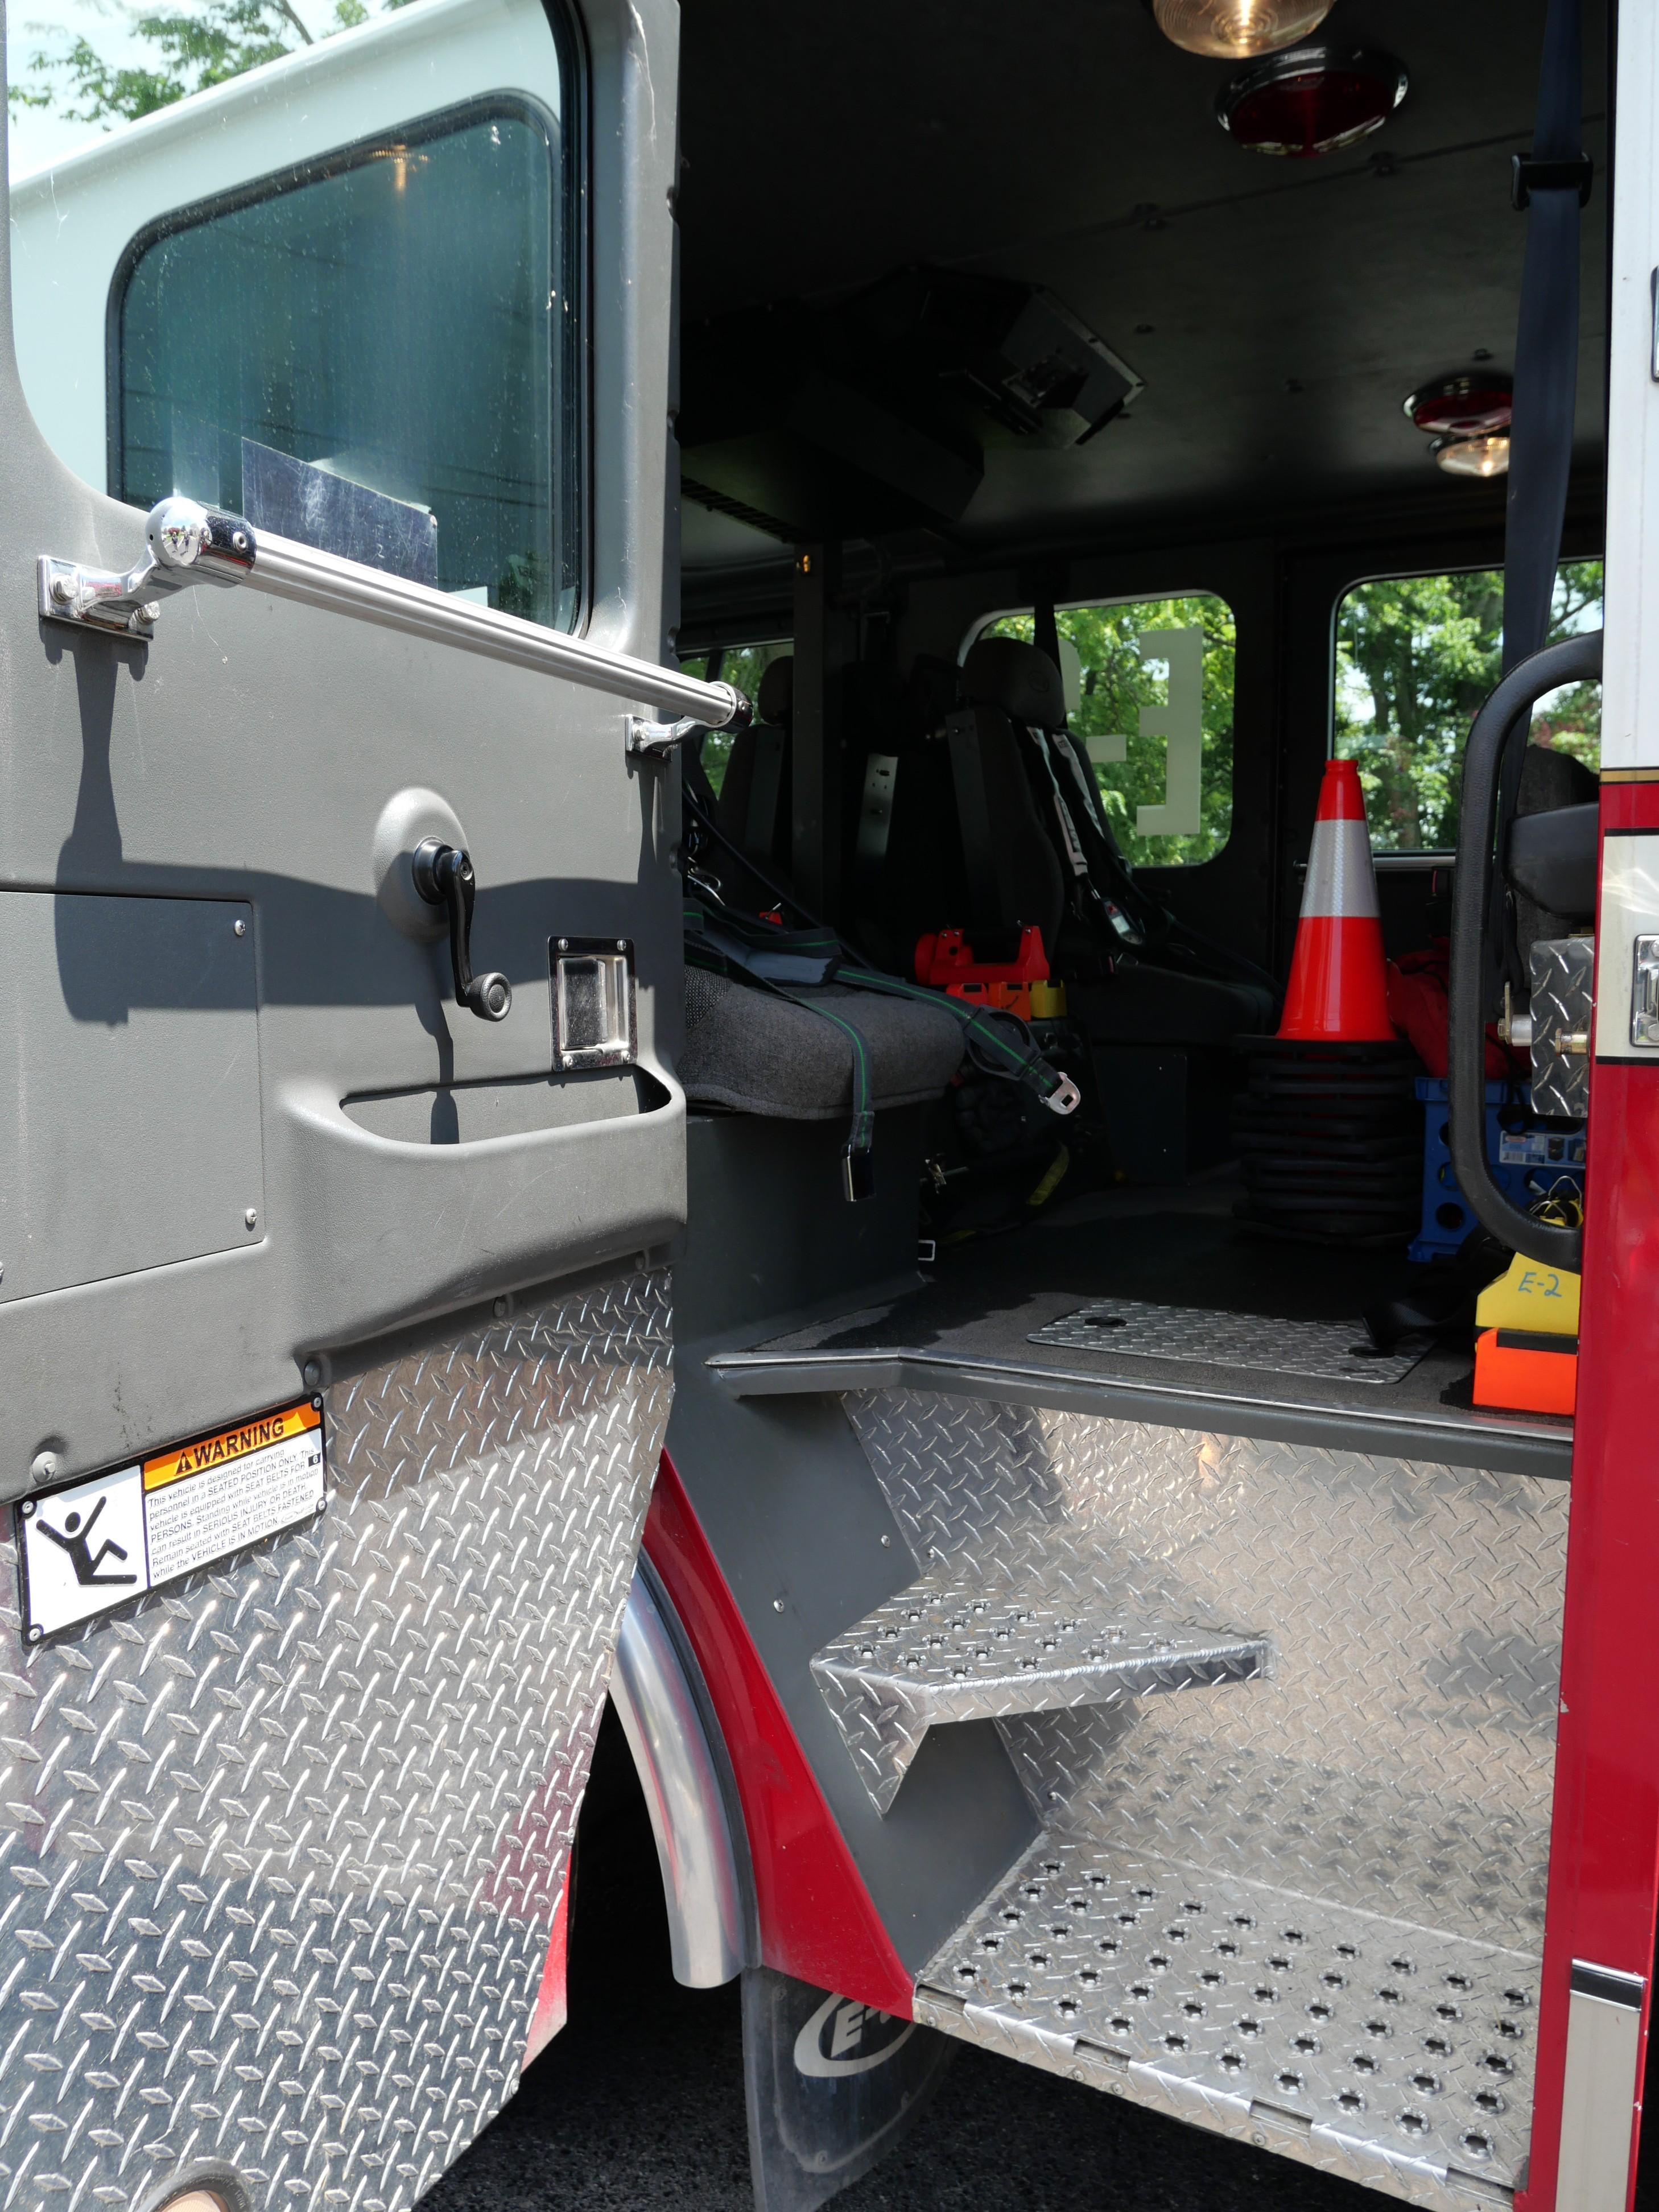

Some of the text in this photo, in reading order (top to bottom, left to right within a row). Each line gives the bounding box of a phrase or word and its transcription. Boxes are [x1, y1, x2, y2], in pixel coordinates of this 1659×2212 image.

[1518, 1272, 1562, 1297] E-2
[193, 1417, 284, 1467] WARNING
[148, 1496, 166, 1507] This
[168, 1484, 196, 1499] vehicle
[207, 1465, 241, 1484] designed
[256, 1450, 284, 1466] carrying
[149, 1496, 189, 1522] personnel
[208, 1478, 238, 1496] SEATED
[241, 1463, 276, 1483] POSITION
[300, 1448, 314, 1457] This
[150, 1514, 179, 1530] vehicle
[190, 1493, 226, 1514] equipped
[228, 1488, 244, 1499] with
[246, 1478, 263, 1492] SEAT
[266, 1468, 288, 1484] BELTS
[291, 1462, 305, 1474] FOR
[312, 1454, 319, 1464] 6
[196, 1505, 230, 1524] Standing
[233, 1496, 251, 1508] while
[254, 1485, 278, 1500] vehicle
[296, 1468, 319, 1483] motion
[152, 1544, 167, 1555] can
[170, 1532, 191, 1546] result
[203, 1512, 238, 1533] SERIOUS
[241, 1500, 267, 1517] INJURY
[270, 1493, 280, 1504] OR
[152, 1549, 183, 1567] Remain
[186, 1536, 212, 1553] seated
[214, 1529, 230, 1540] with
[232, 1517, 251, 1532] SEAT
[253, 1507, 276, 1522] BELTS
[278, 1490, 314, 1512] FASTENED
[154, 1564, 175, 1578] while
[177, 1558, 189, 1568] the
[192, 1540, 226, 1561] VEHICLE
[229, 1536, 236, 1545] IS
[238, 1531, 245, 1540] IN
